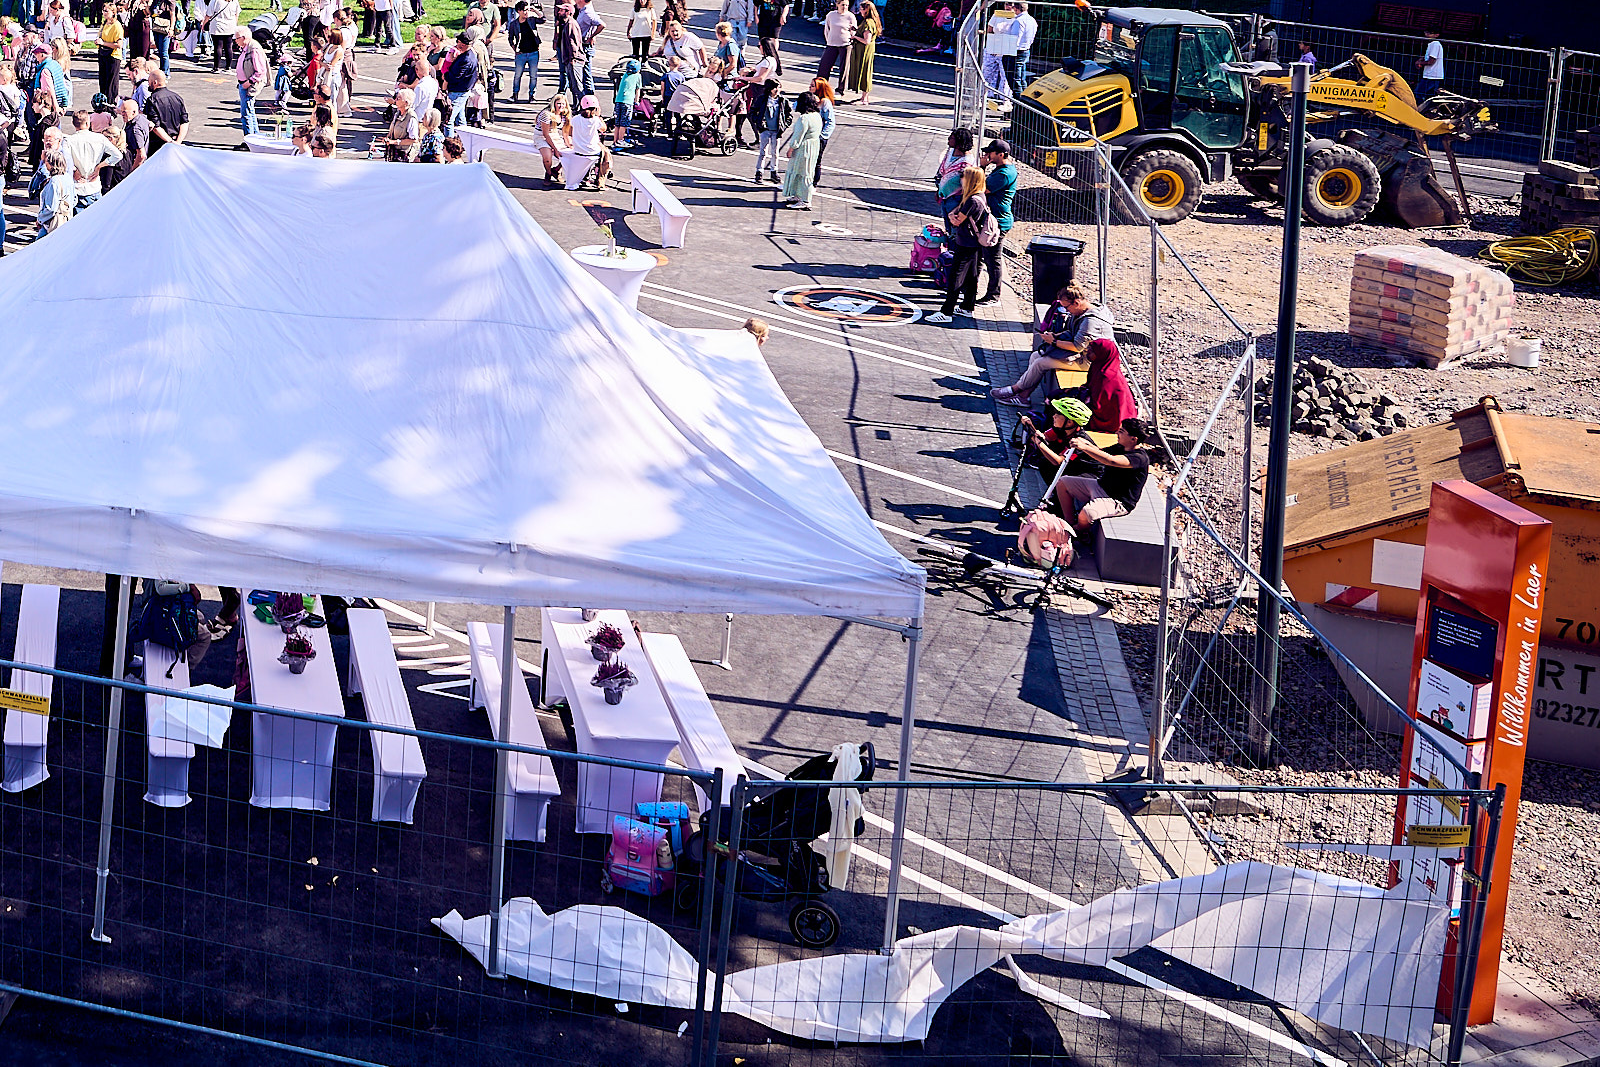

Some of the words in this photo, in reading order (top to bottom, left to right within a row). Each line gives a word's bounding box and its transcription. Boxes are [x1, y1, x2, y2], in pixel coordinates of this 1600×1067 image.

[1311, 85, 1376, 99] NNIGMANN
[1383, 434, 1423, 512] OVERTHEIL
[1514, 563, 1542, 610] Laer
[1516, 616, 1538, 634] in
[1555, 617, 1600, 645] 70
[1498, 640, 1535, 747] Willkommen
[1537, 657, 1597, 695] RT
